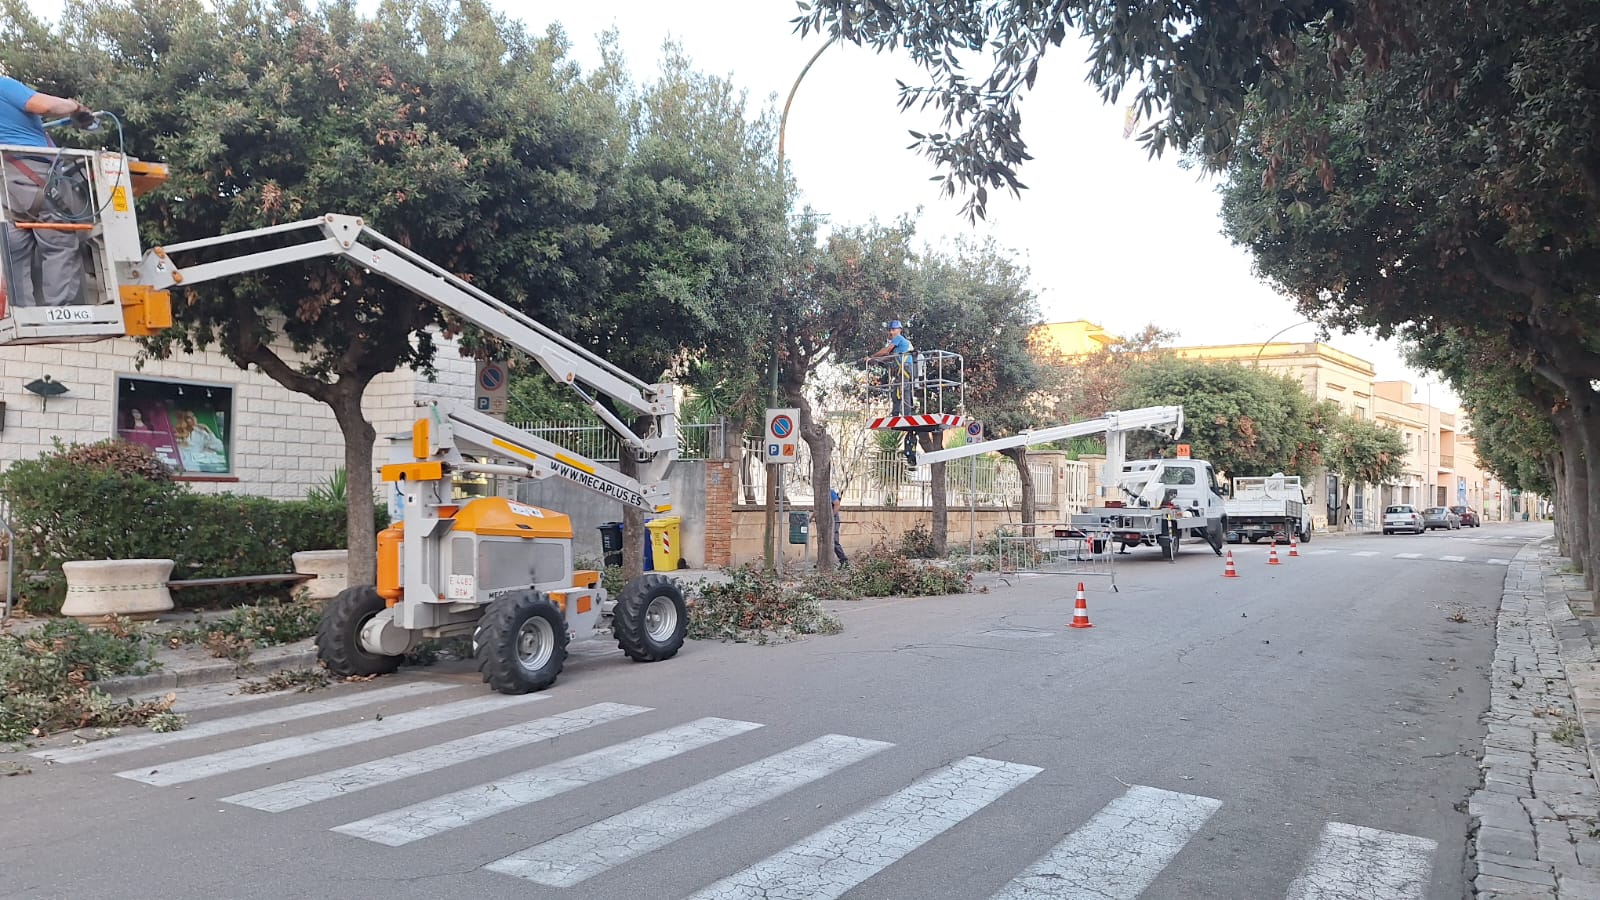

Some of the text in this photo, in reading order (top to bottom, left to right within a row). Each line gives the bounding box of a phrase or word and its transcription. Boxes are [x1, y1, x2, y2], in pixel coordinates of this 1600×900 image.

[48, 309, 89, 320] 120 KG
[550, 461, 642, 506] WWW.MECAPLUS.ES
